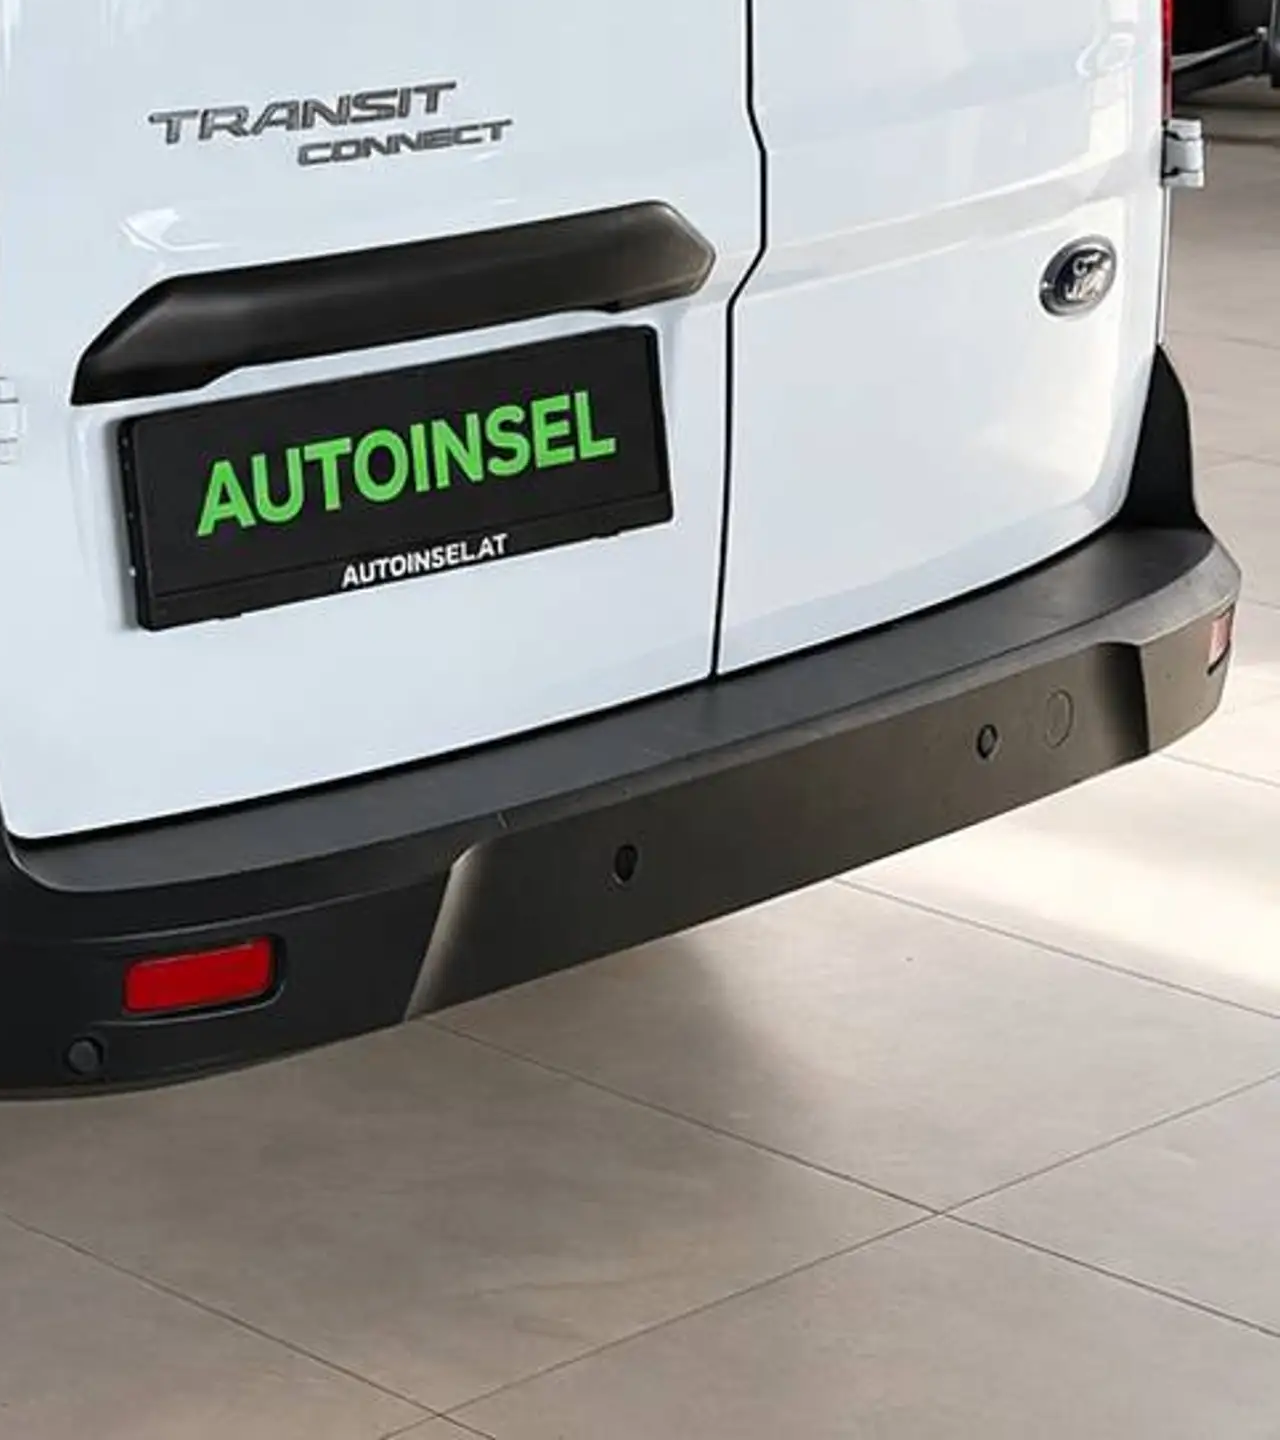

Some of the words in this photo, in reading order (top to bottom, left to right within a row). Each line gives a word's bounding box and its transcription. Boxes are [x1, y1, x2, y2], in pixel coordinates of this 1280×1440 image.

[148, 81, 457, 145] TRANSIT
[297, 119, 513, 166] CONNECT
[197, 392, 615, 535] AUTOINSEL
[341, 532, 508, 589] AUTOINSEL.AT
